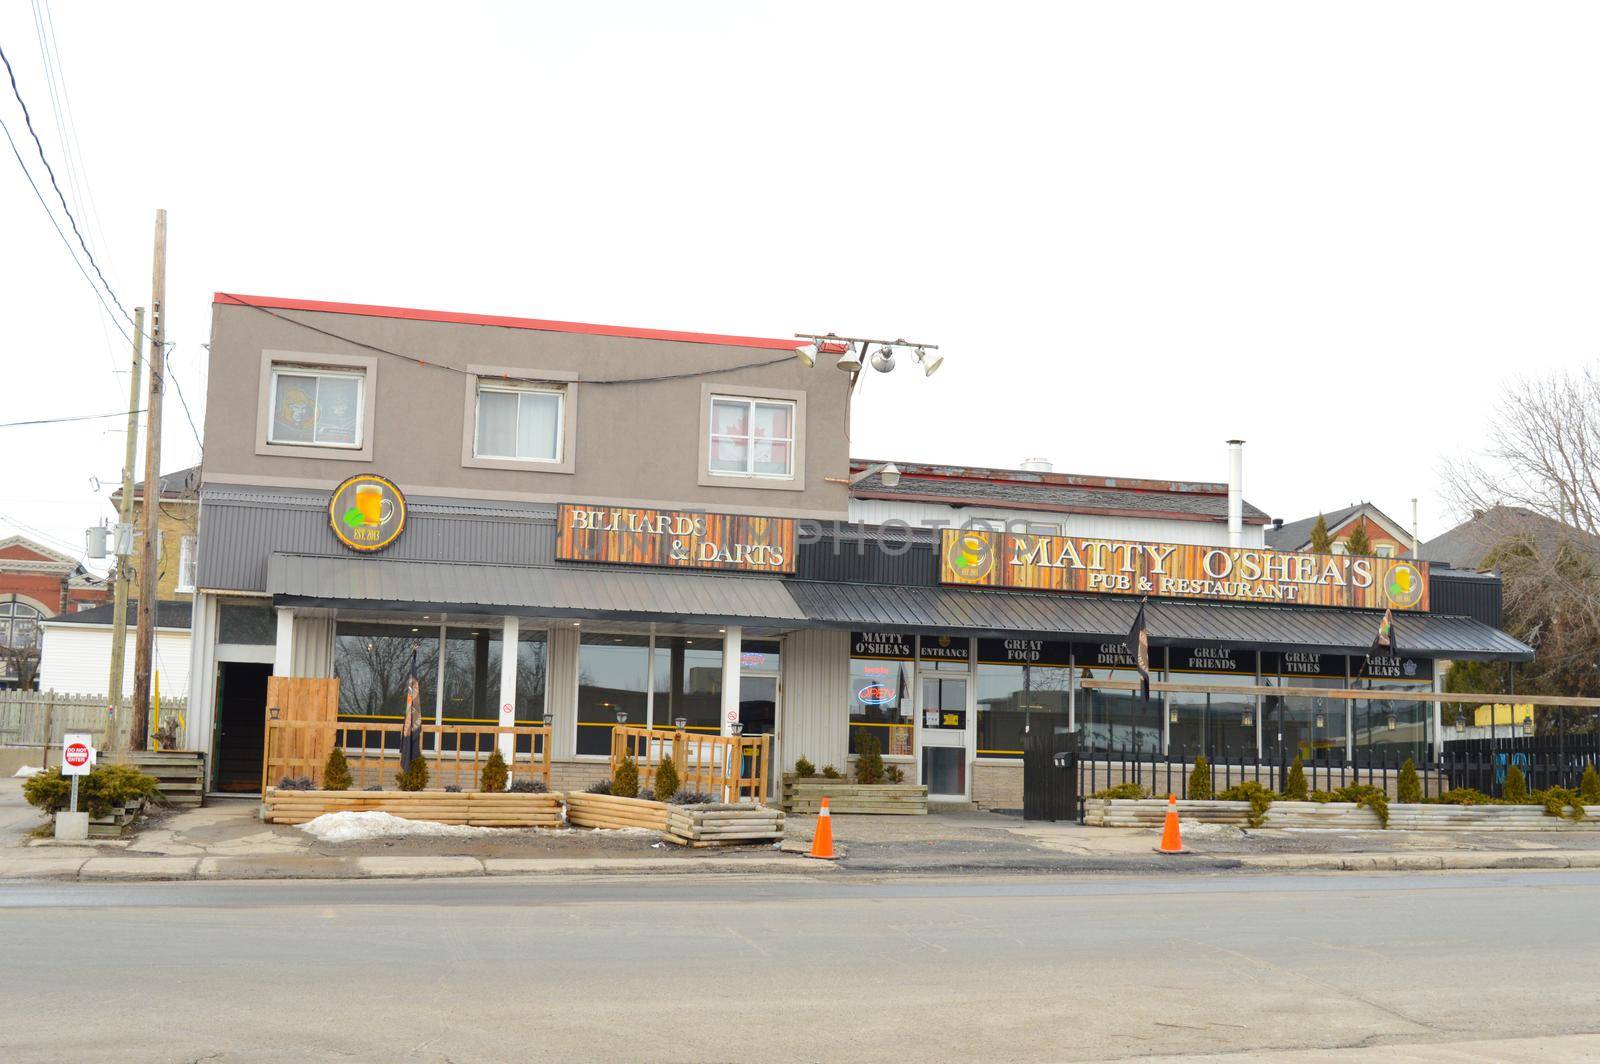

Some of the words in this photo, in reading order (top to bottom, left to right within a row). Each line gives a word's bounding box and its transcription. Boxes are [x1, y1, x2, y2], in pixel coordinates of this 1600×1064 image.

[570, 509, 707, 537] BILLIARDS
[670, 539, 690, 561] &
[698, 541, 784, 567] DARTS
[1009, 536, 1177, 575] MATTY
[1202, 550, 1374, 588] O'SHEA'S
[1089, 573, 1131, 590] PUB
[1138, 576, 1153, 591] &
[1161, 577, 1299, 600] RESTAURANT
[862, 632, 904, 644] MATTY
[855, 642, 910, 656] O'SHEA'S
[1004, 639, 1043, 651] GREAT
[921, 646, 968, 658] ENTRANCE
[1007, 649, 1040, 661] FOOD
[1194, 647, 1231, 659] GREAT
[1285, 651, 1320, 663] GREAT
[1097, 653, 1138, 665] DRINK
[1188, 657, 1237, 670] FRIENDS
[1367, 655, 1401, 667] GREAT
[1286, 662, 1321, 673] TIMES
[1368, 665, 1401, 677] LEAFS
